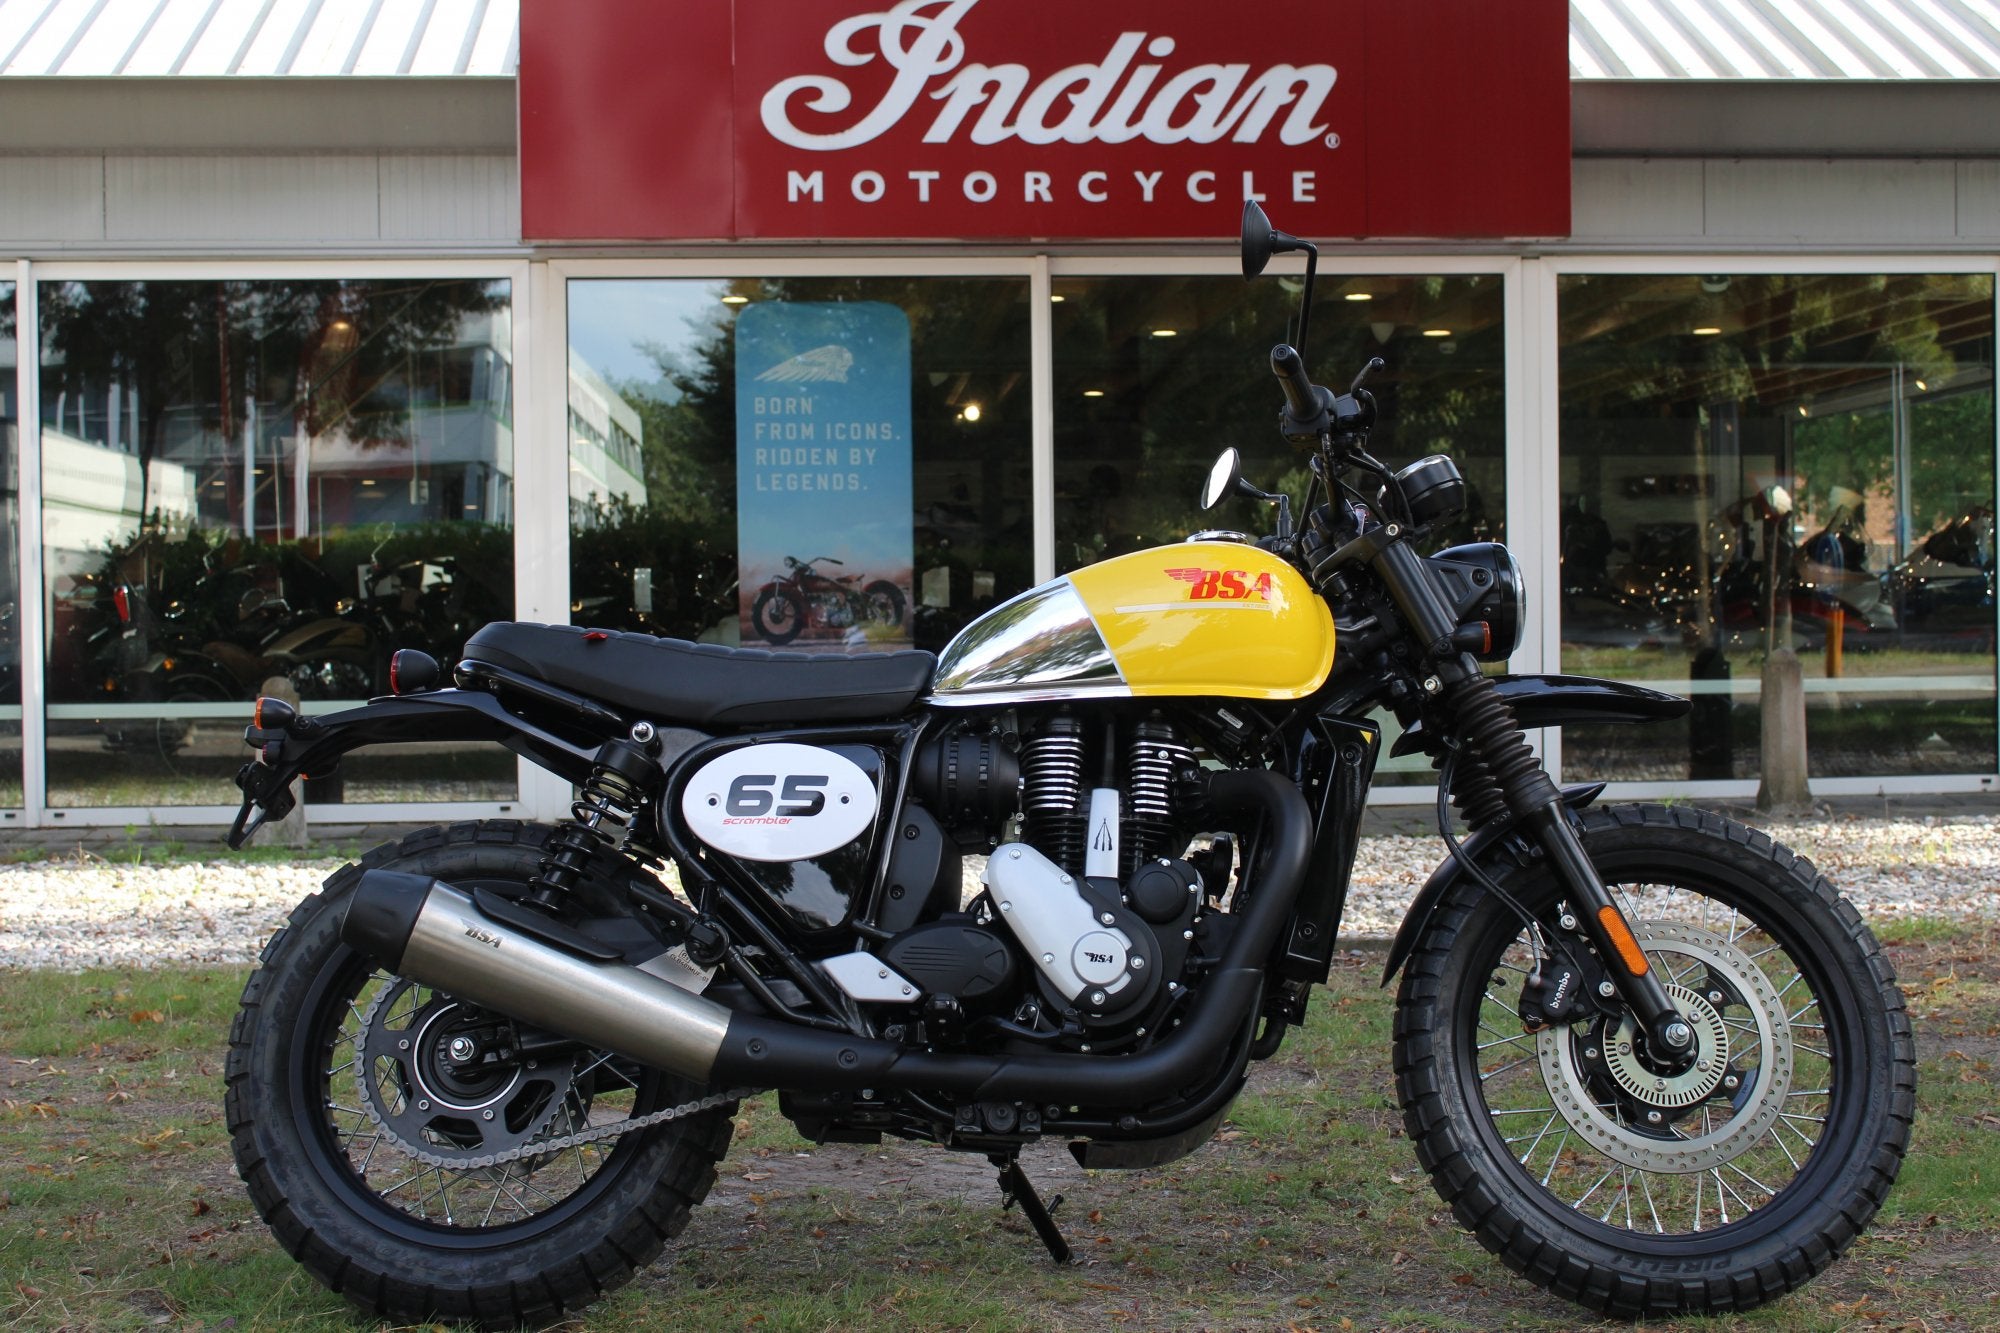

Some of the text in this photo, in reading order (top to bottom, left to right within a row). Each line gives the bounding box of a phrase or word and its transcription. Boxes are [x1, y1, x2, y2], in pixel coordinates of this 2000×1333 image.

[788, 171, 1316, 202] MOTORCYCLE
[754, 397, 813, 415] BORN
[755, 423, 901, 441] FROM ICONS.
[756, 448, 877, 466] RIDDEN BY
[756, 473, 869, 491] LEGENDS.
[1190, 570, 1271, 600] BSA
[725, 774, 829, 817] 65
[722, 817, 793, 825] scrambler
[465, 927, 504, 949] BSA
[1089, 953, 1113, 964] BSA
[1549, 972, 1571, 1009] brembo
